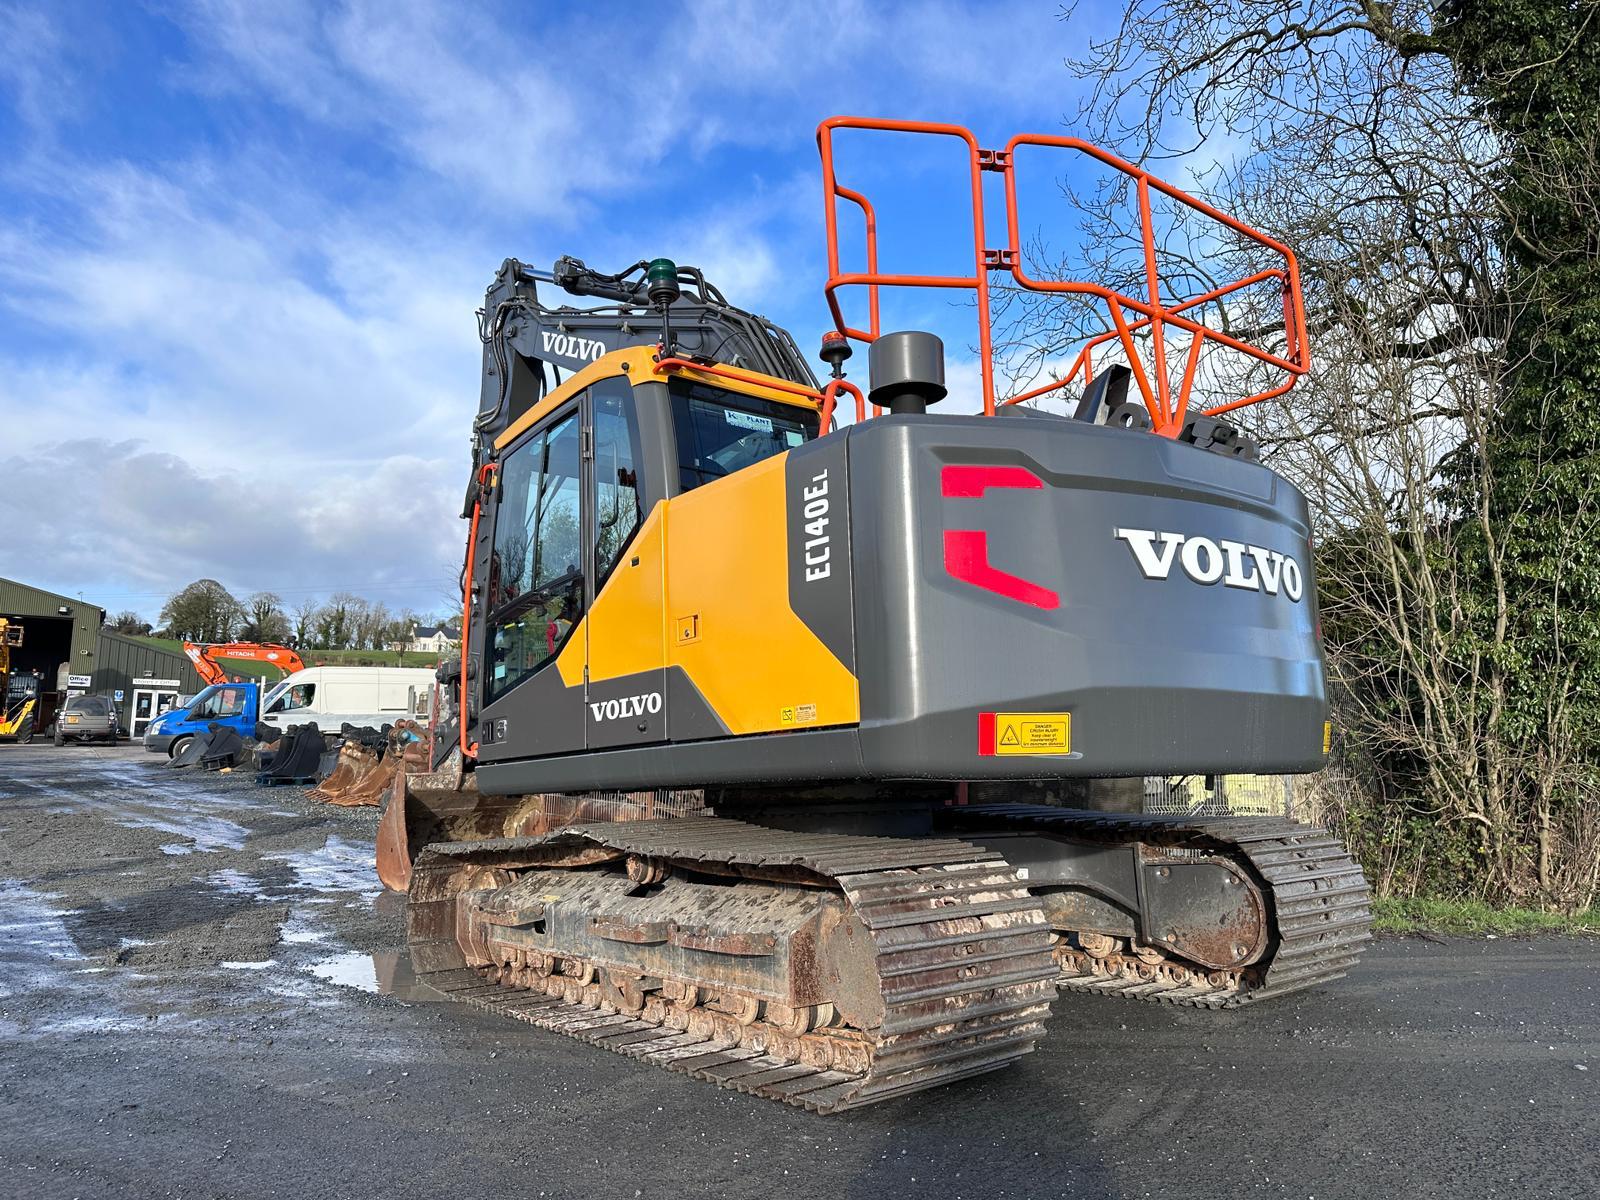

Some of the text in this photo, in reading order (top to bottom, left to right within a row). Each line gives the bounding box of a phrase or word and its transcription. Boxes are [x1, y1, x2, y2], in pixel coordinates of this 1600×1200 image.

[541, 331, 606, 362] VOLVO
[746, 415, 770, 425] PLANT
[1113, 526, 1304, 603] VOLVO
[589, 692, 662, 722] VOLVO
